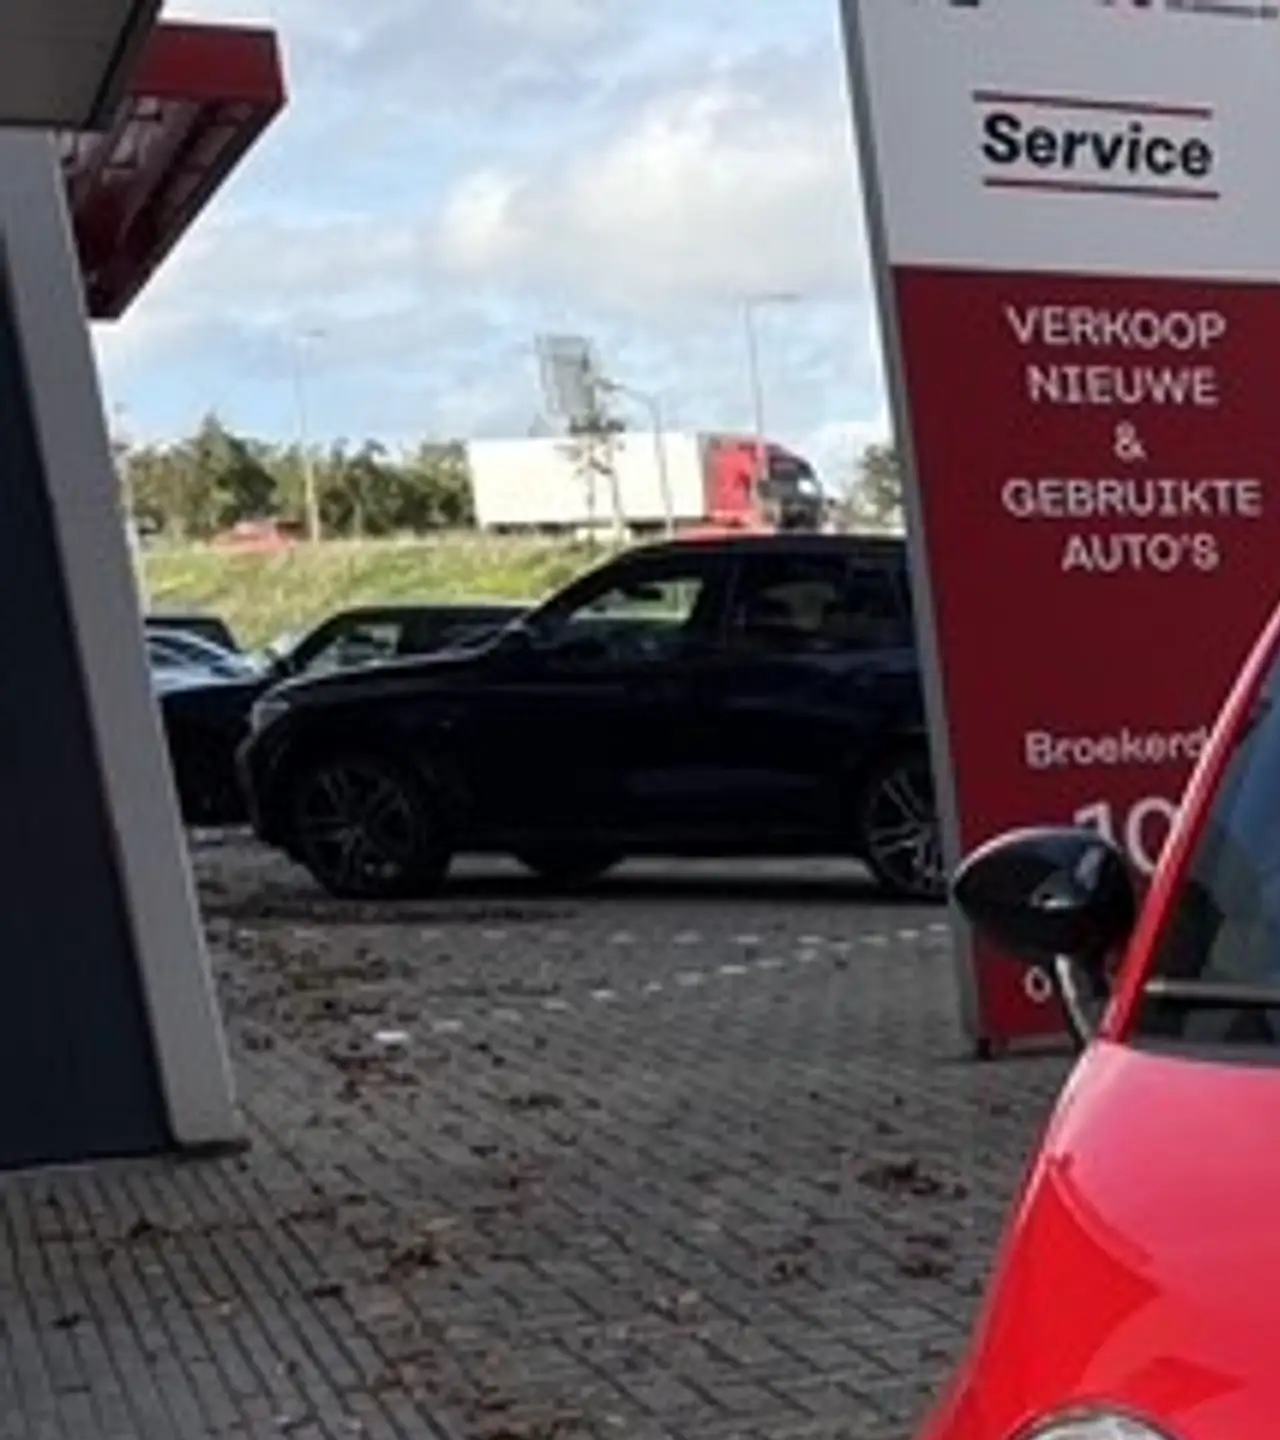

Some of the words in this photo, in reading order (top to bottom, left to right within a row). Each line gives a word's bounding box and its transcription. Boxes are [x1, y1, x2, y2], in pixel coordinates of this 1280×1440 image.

[980, 112, 1213, 177] Service
[1005, 304, 1227, 351] VERKOOP
[1026, 365, 1220, 406] NIEUWE
[1113, 422, 1146, 461] &
[1002, 478, 1263, 519] GEBRUIKTE
[1061, 532, 1220, 572] AUTO'S
